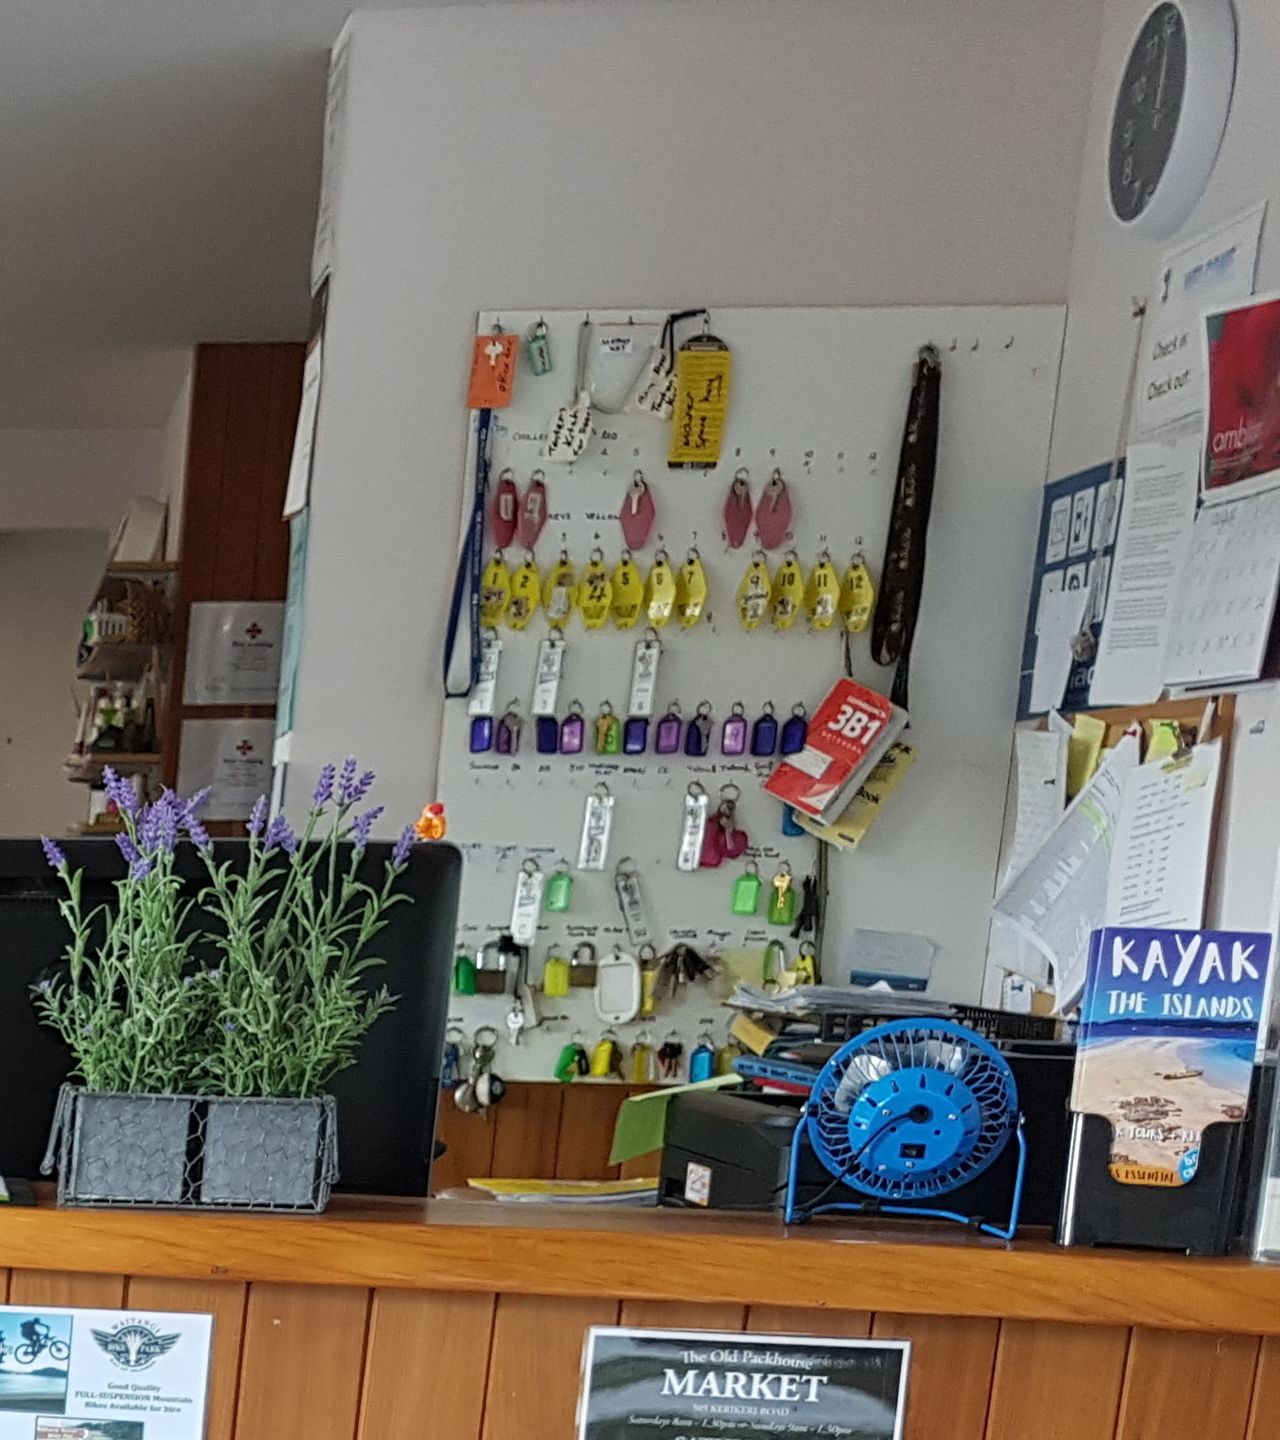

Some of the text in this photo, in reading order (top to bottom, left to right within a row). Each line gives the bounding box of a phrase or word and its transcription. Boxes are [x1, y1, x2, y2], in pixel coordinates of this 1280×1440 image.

[520, 575, 529, 588] 2
[827, 704, 881, 745] 3B1
[1111, 934, 1259, 986] KAYAK
[1107, 989, 1254, 1019] THE ISLANDS
[679, 1351, 813, 1371] The Old Packhouse
[660, 1368, 828, 1402] MARKET
